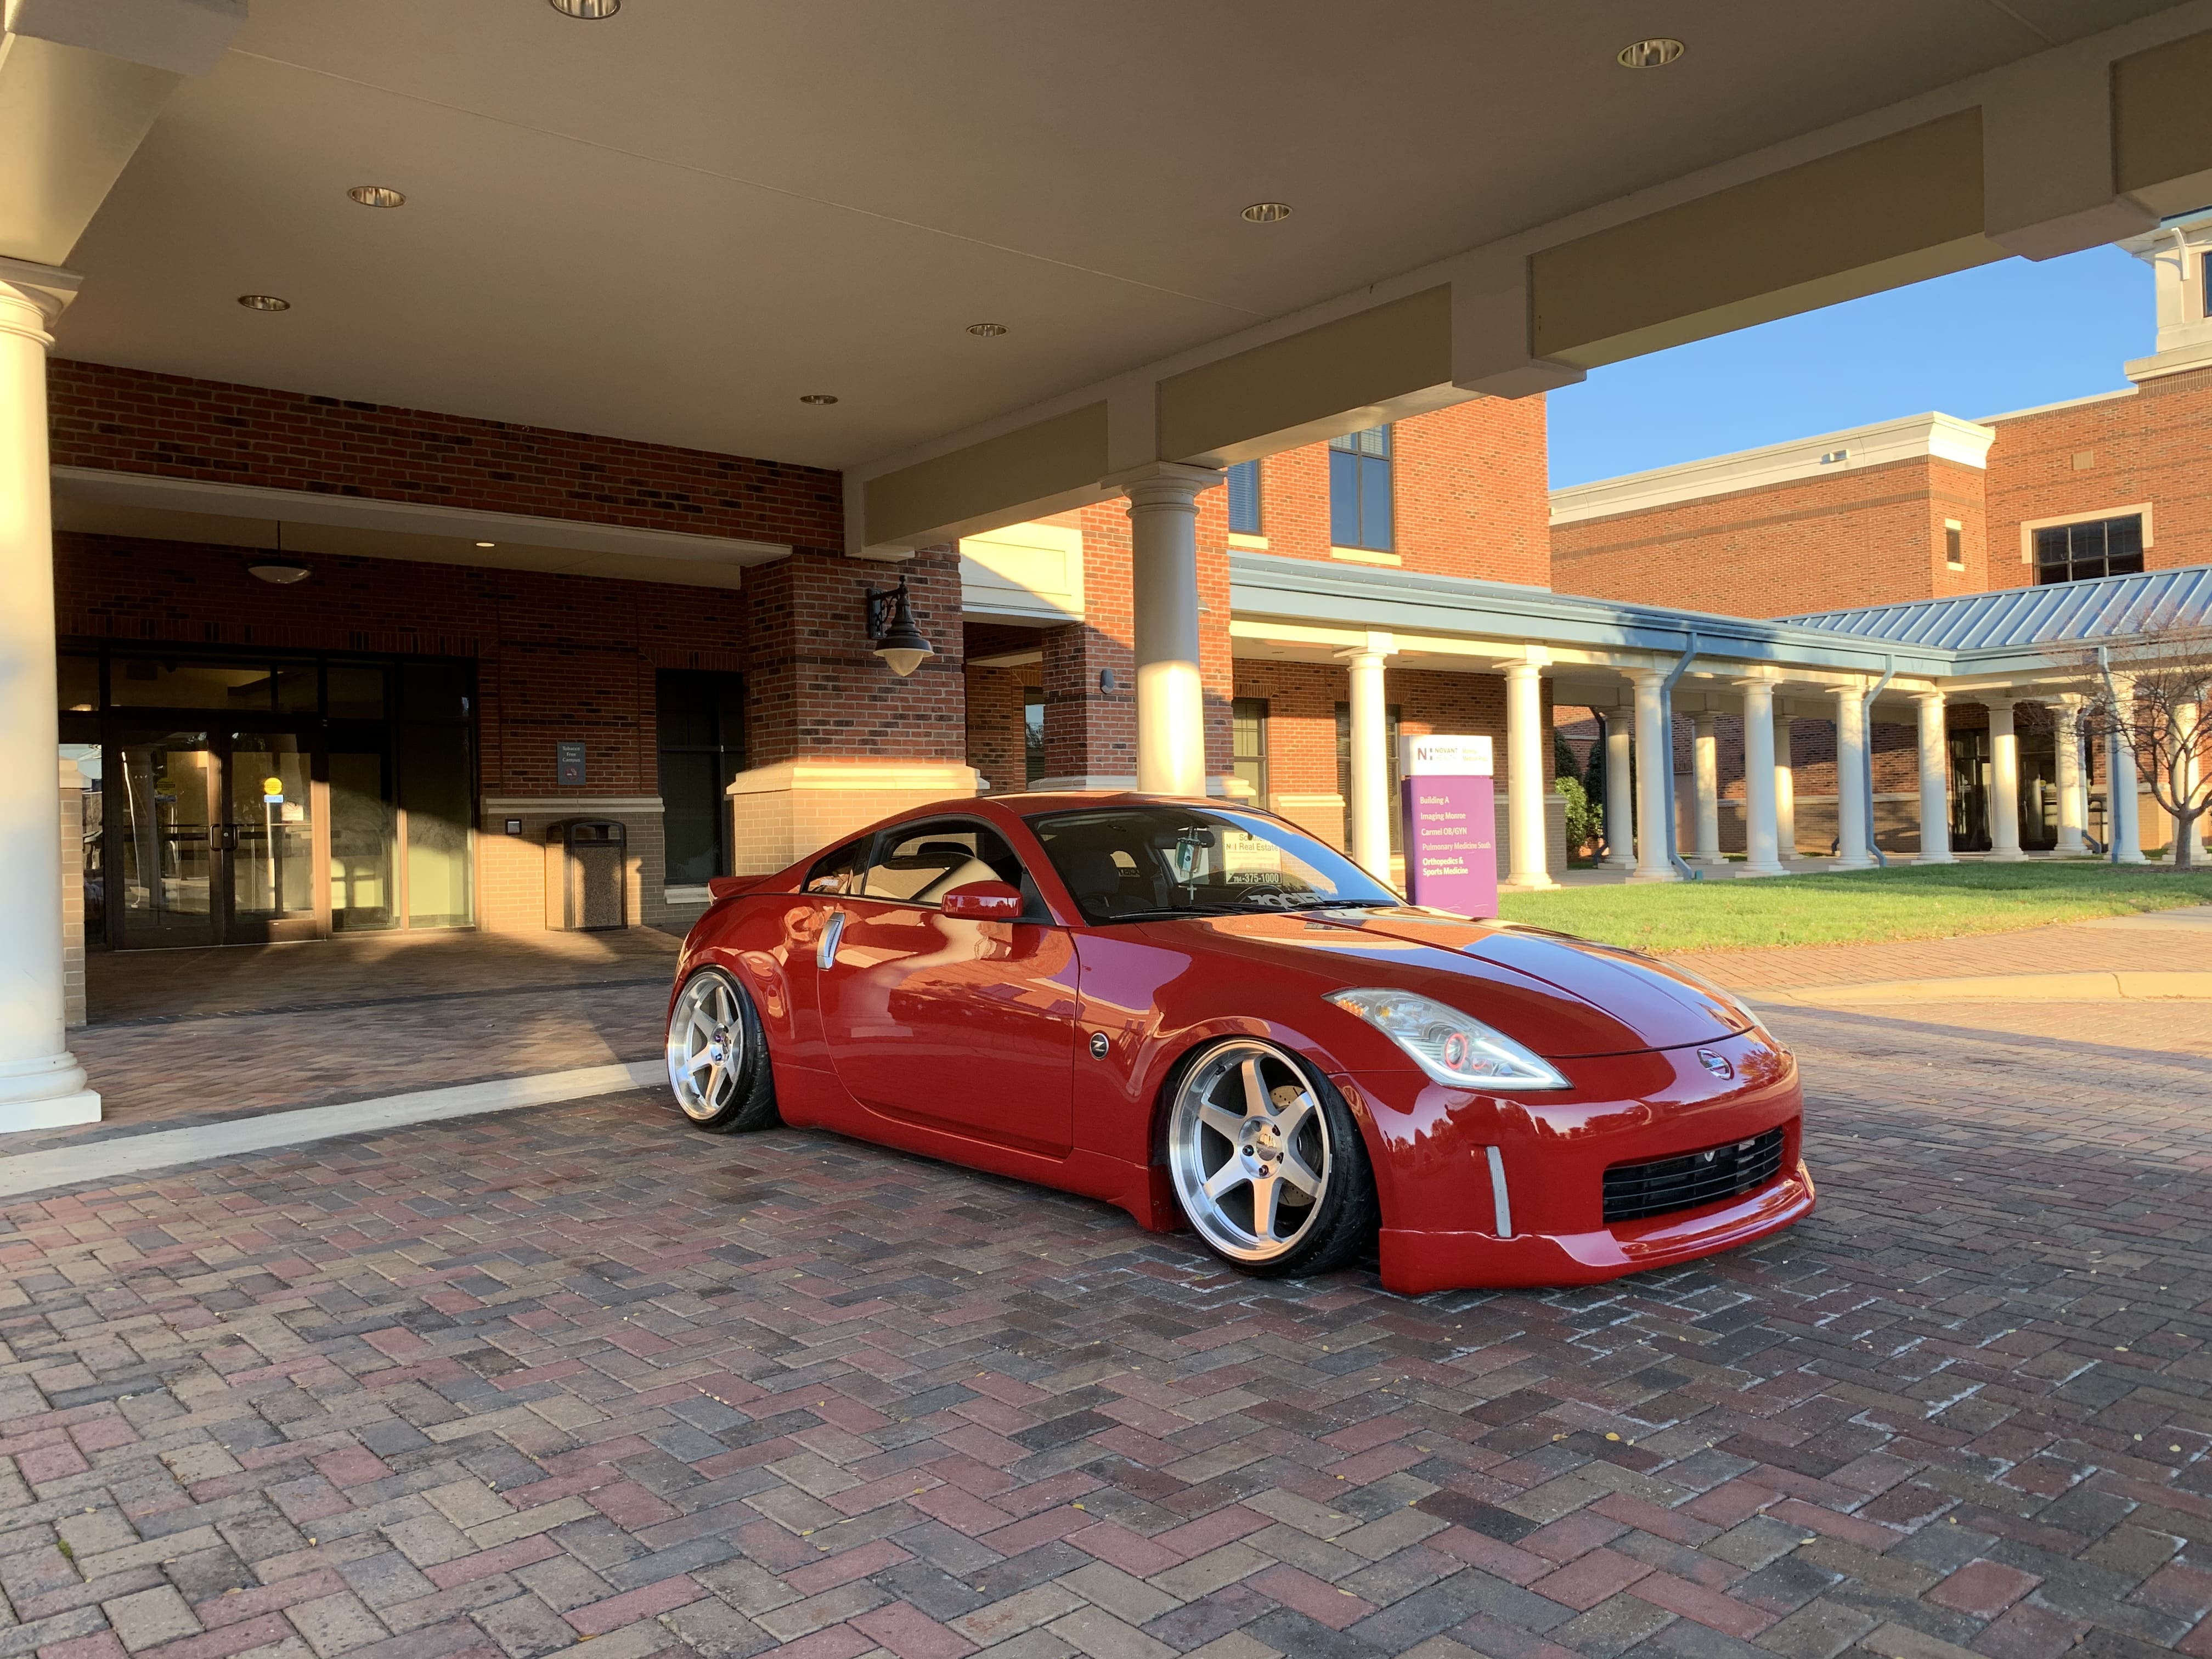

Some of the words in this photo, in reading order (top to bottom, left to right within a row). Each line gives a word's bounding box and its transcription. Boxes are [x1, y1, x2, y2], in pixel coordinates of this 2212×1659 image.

[1420, 797, 1444, 805] Building
[1420, 812, 1444, 821] Imaging
[1421, 828, 1442, 836] Carmel
[1443, 827, 1467, 836] OB/GYN
[1454, 842, 1477, 850] Medicine
[1477, 841, 1491, 849] South
[1423, 857, 1458, 867] Orthopedics
[1459, 856, 1464, 865] &
[1423, 868, 1443, 877] Sports
[1443, 867, 1469, 875] Medicine
[1233, 873, 1279, 883] 704-375-1000
